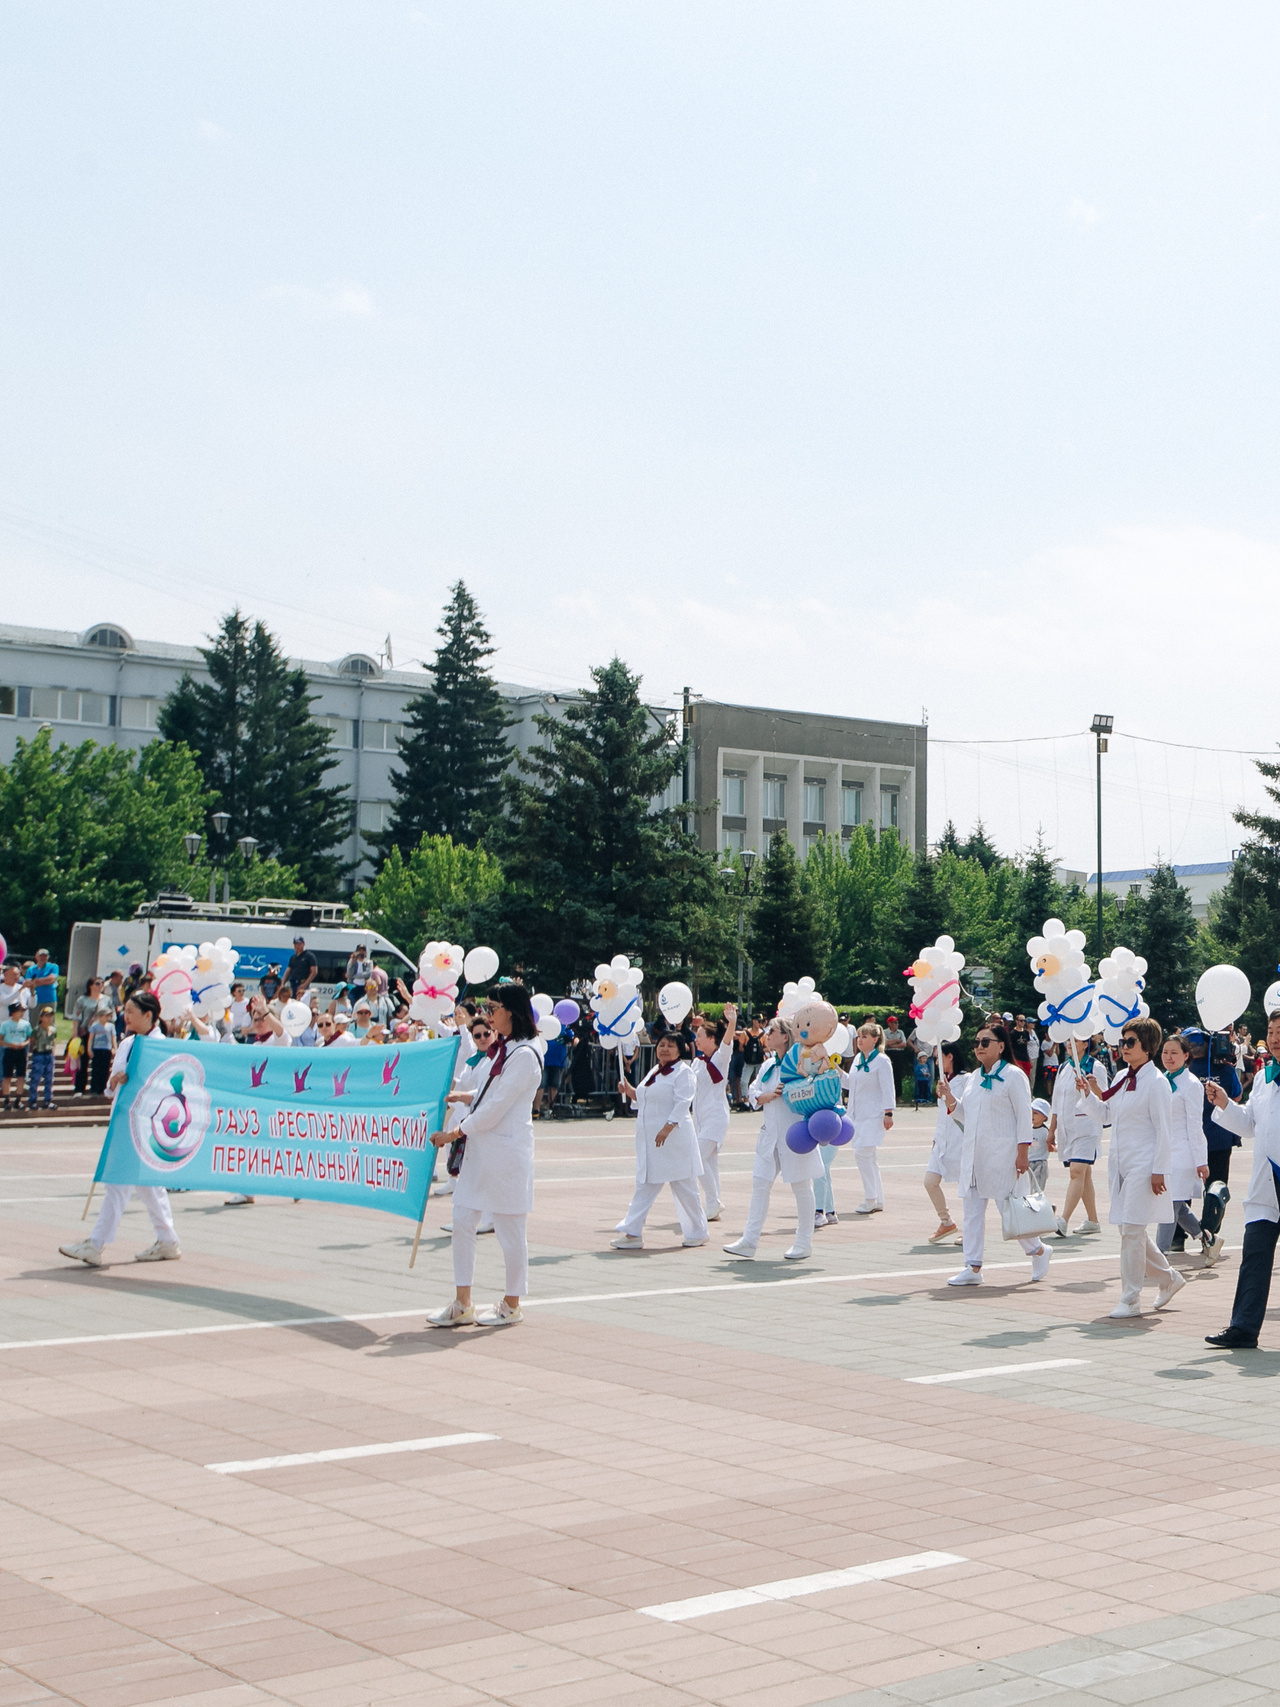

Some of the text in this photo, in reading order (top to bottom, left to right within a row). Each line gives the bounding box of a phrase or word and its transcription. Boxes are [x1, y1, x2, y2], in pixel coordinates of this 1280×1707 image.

[214, 1108, 429, 1151] ГАУЗ «РЕСПУБЛИКАНСКИЙ
[212, 1146, 410, 1192] ПЕРИНАТАЛЬНЫЙ ЦЕНТР»
